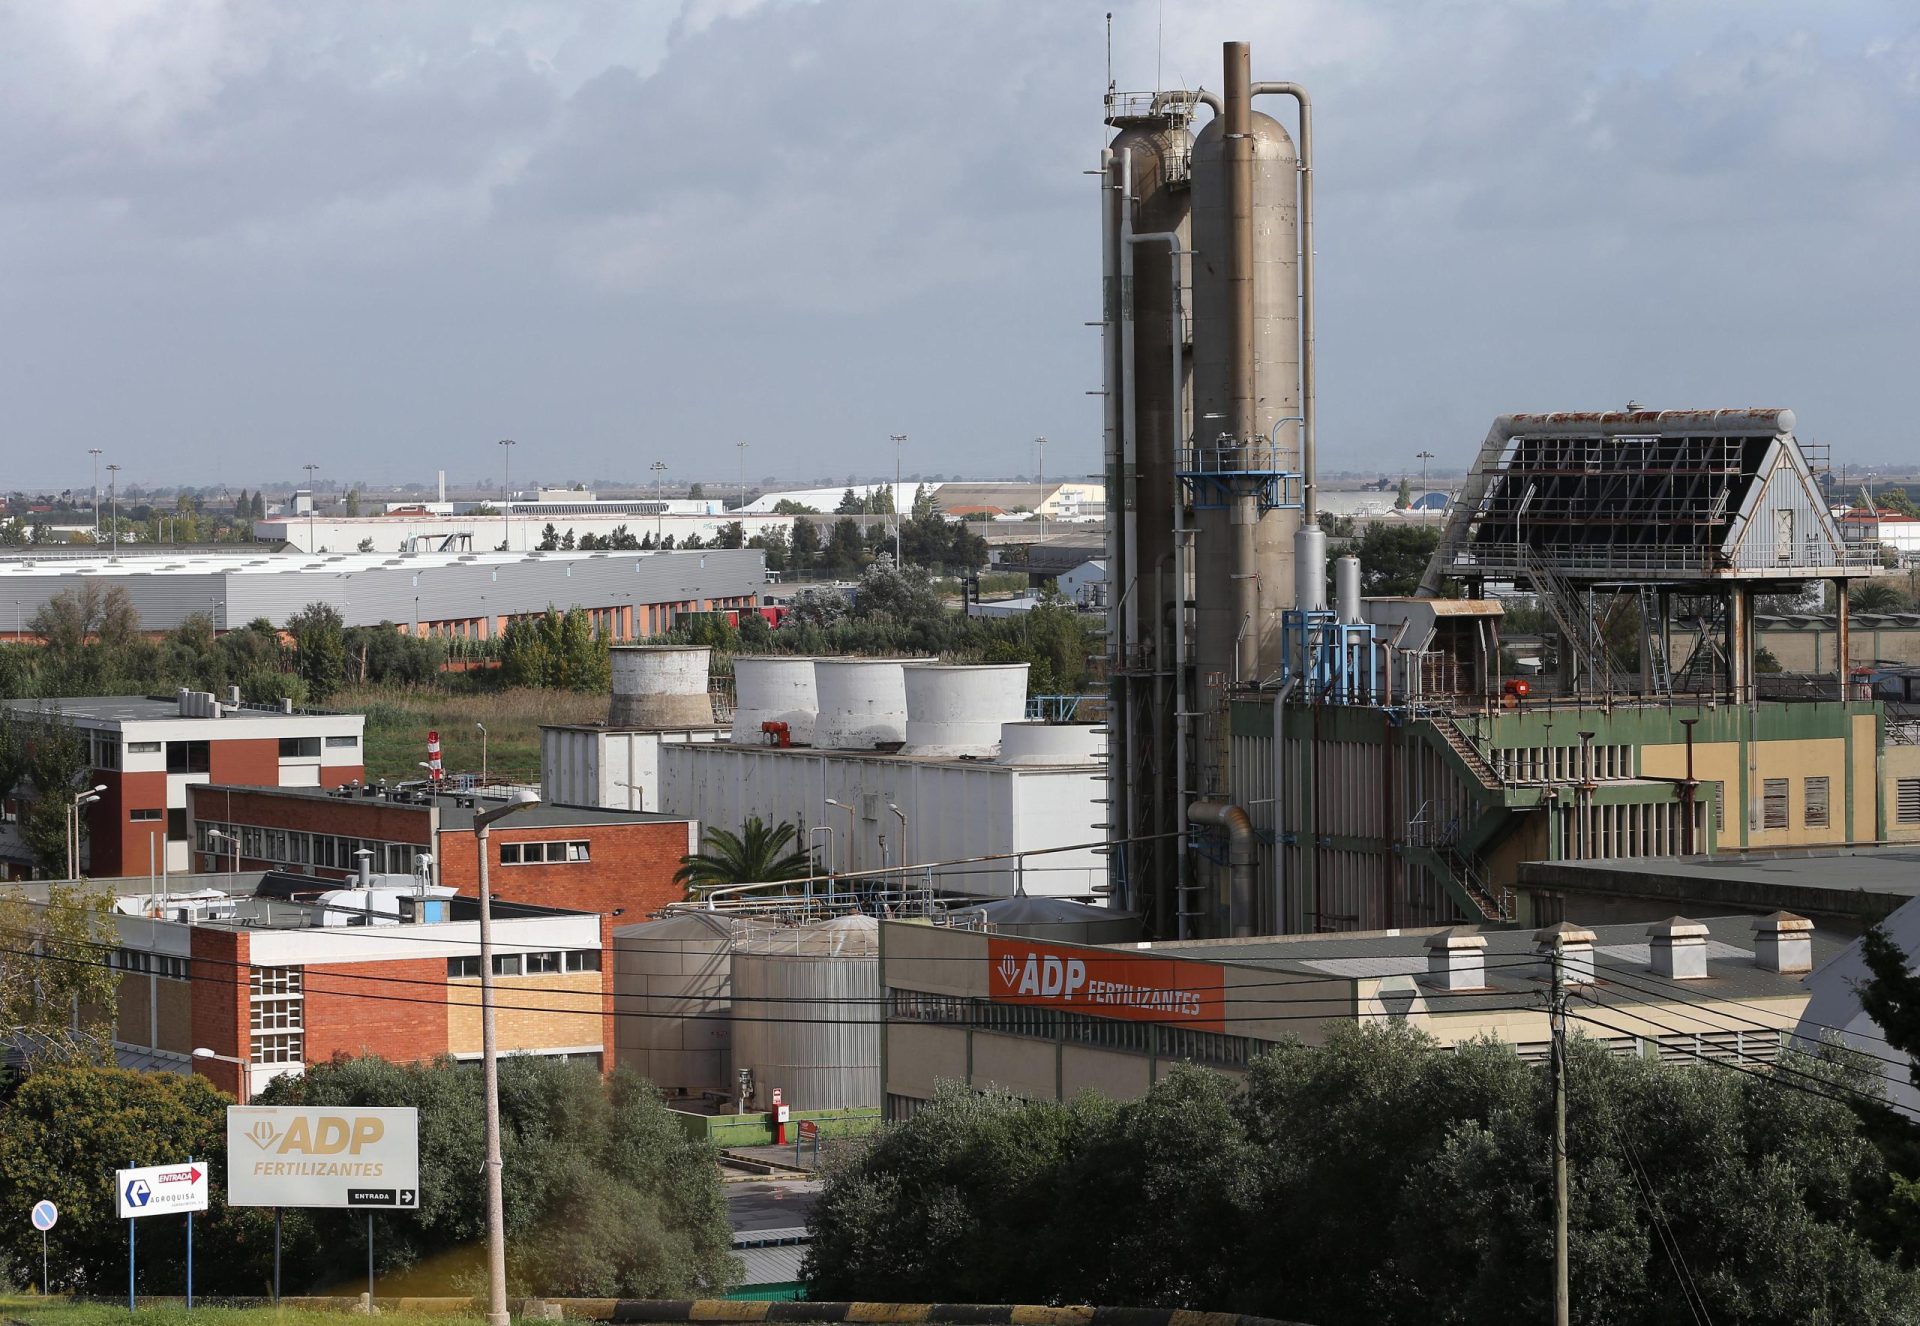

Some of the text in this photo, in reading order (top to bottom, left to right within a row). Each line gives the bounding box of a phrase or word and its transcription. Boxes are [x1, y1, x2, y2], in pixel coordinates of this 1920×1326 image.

[1018, 953, 1201, 1016] ADP FERTILIZANTES
[276, 1116, 385, 1155] ADP
[253, 1161, 384, 1177] FERTILIZANTES
[159, 1172, 192, 1183] ENTRADA
[150, 1192, 195, 1203] AGROQUISA
